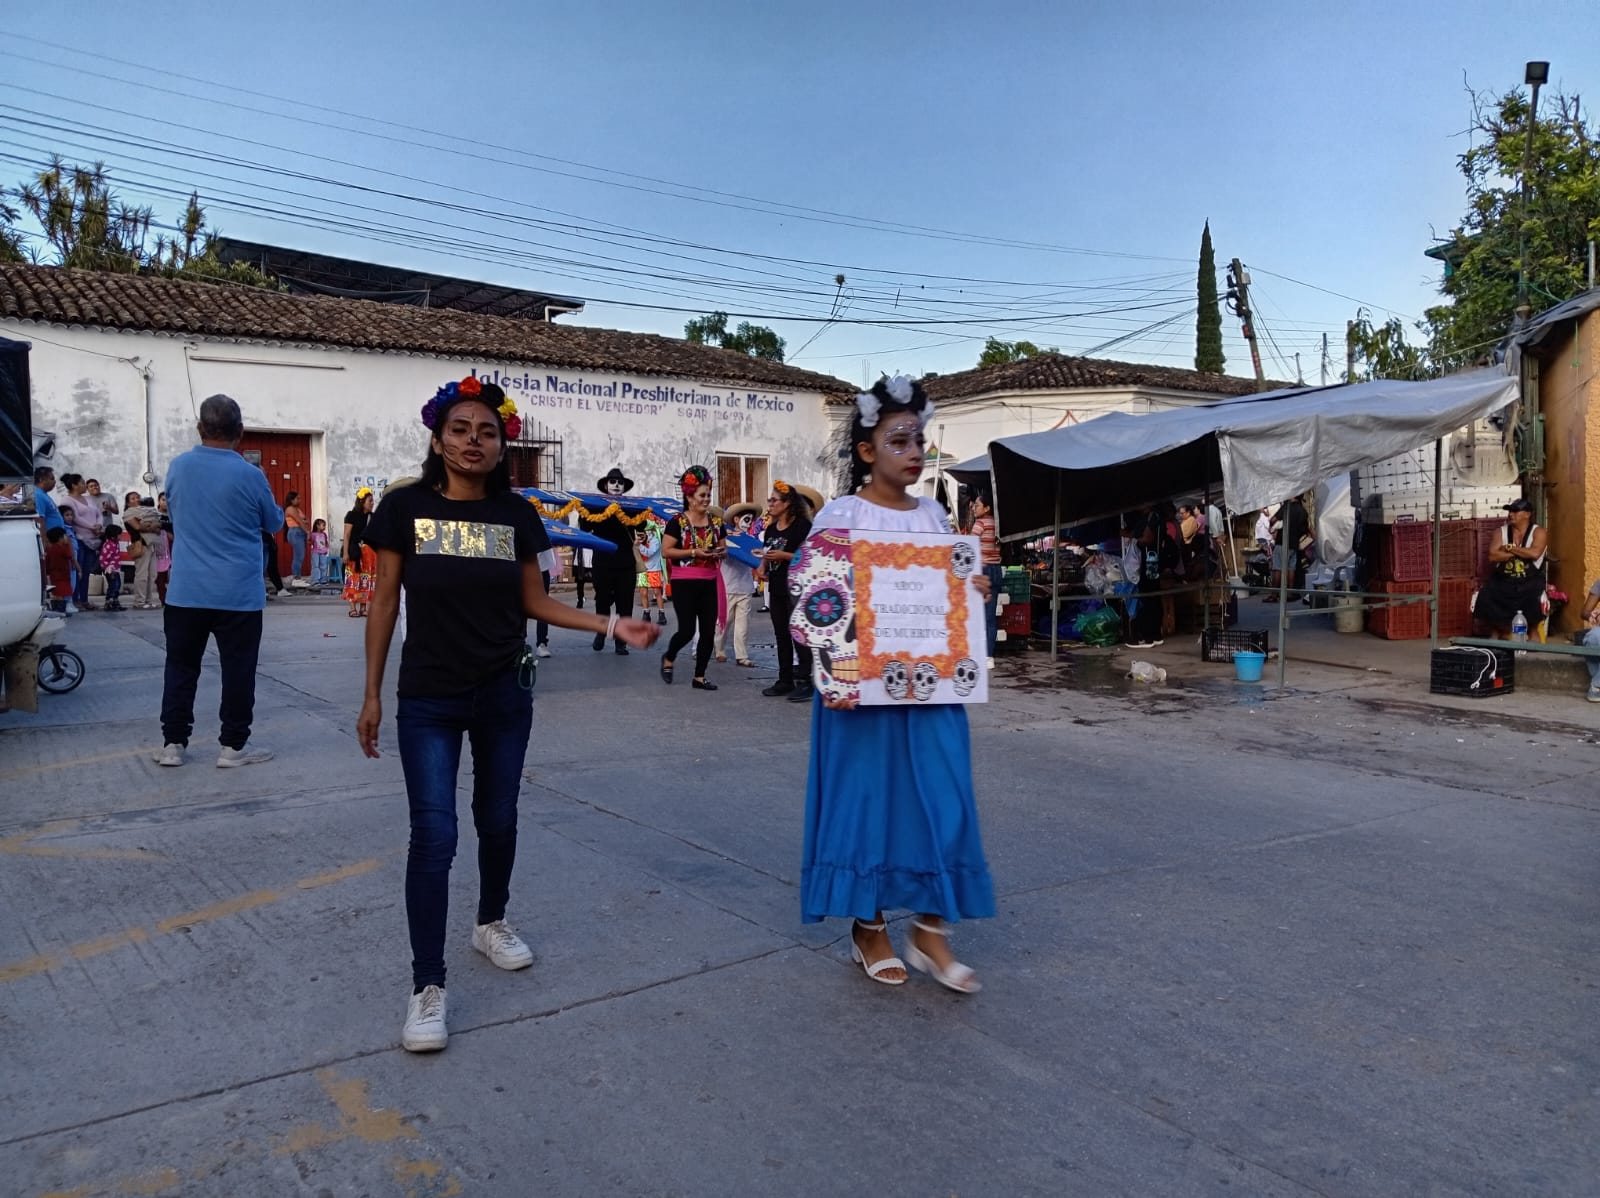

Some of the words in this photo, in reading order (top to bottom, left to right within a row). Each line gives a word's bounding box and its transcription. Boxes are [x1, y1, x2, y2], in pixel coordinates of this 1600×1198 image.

[546, 375, 617, 399] Nacional
[621, 382, 721, 407] Presbiteriana
[726, 391, 742, 408] de
[746, 393, 794, 412] México
[577, 398, 592, 411] EL
